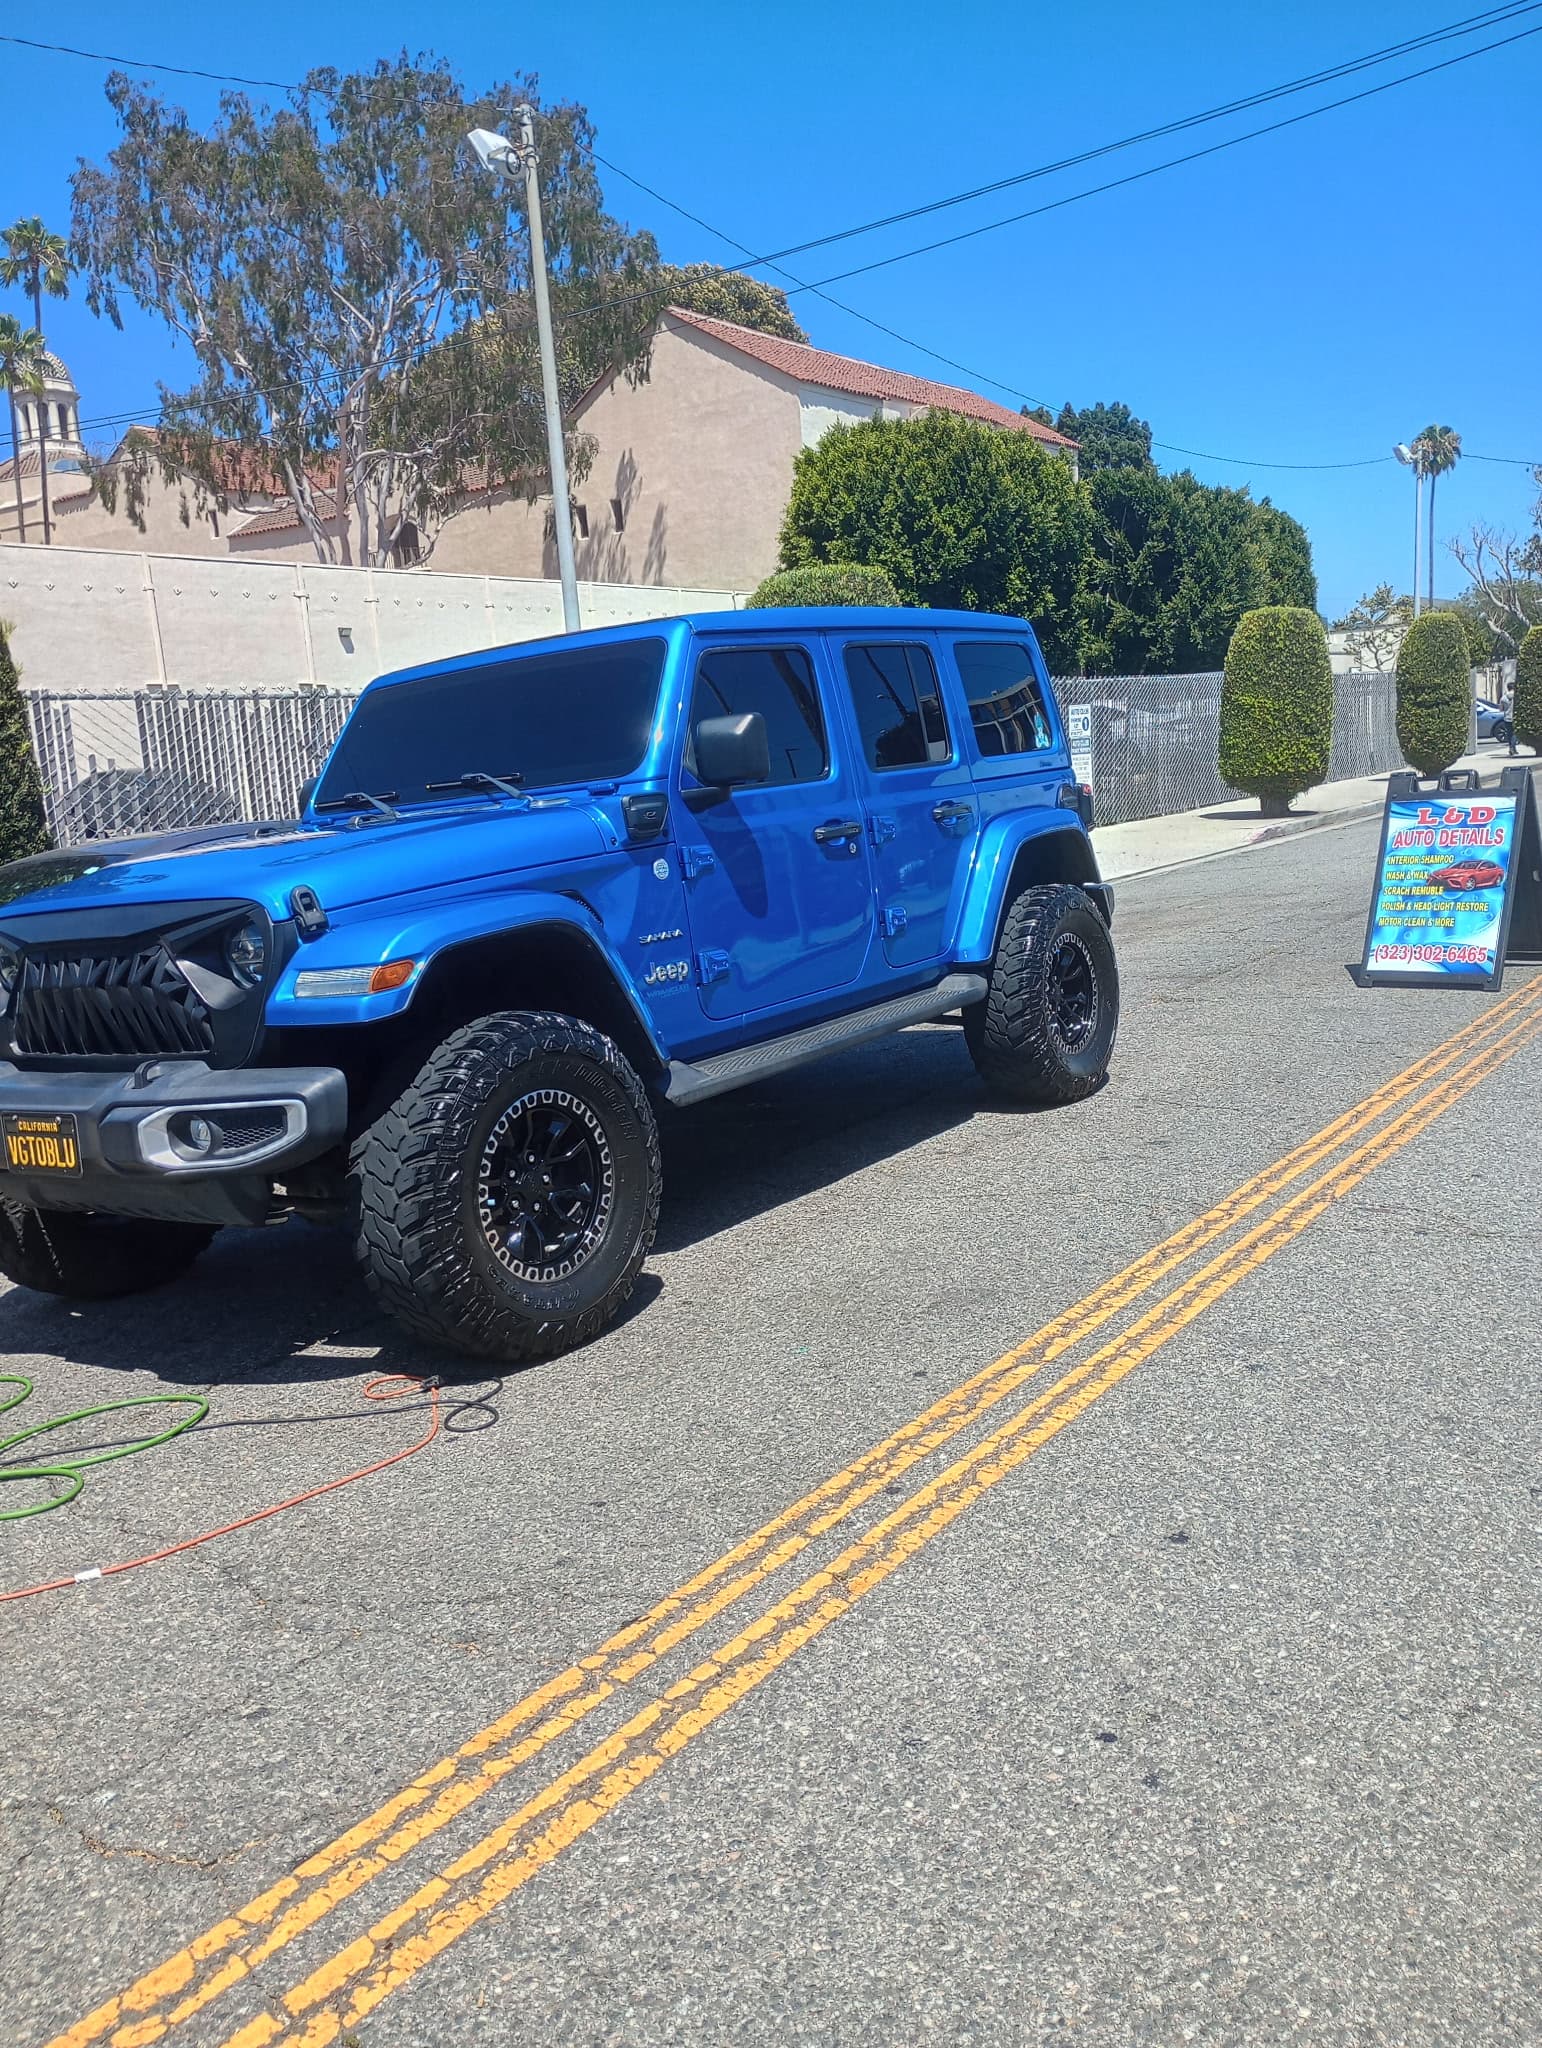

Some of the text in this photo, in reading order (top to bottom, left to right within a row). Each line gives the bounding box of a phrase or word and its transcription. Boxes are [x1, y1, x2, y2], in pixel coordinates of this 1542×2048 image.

[1417, 806, 1496, 825] L & D
[1393, 829, 1504, 847] AUTO DETAILS
[1388, 855, 1454, 865] INTERIOR SHAMPOO
[1386, 871, 1405, 880] WASH
[1412, 871, 1429, 880] WAX
[1384, 886, 1444, 896] SCRACH REMUBLE
[1382, 902, 1405, 911] POLISH
[1406, 902, 1412, 911] &
[1455, 902, 1489, 912] RESTORE
[1378, 917, 1456, 927] MOTOR CLEAN & MORE
[1375, 945, 1488, 964] (323)302-6465
[643, 961, 689, 984] Jeep
[18, 1121, 58, 1132] CALIFORNIA
[7, 1135, 76, 1168] VGTOBLU
